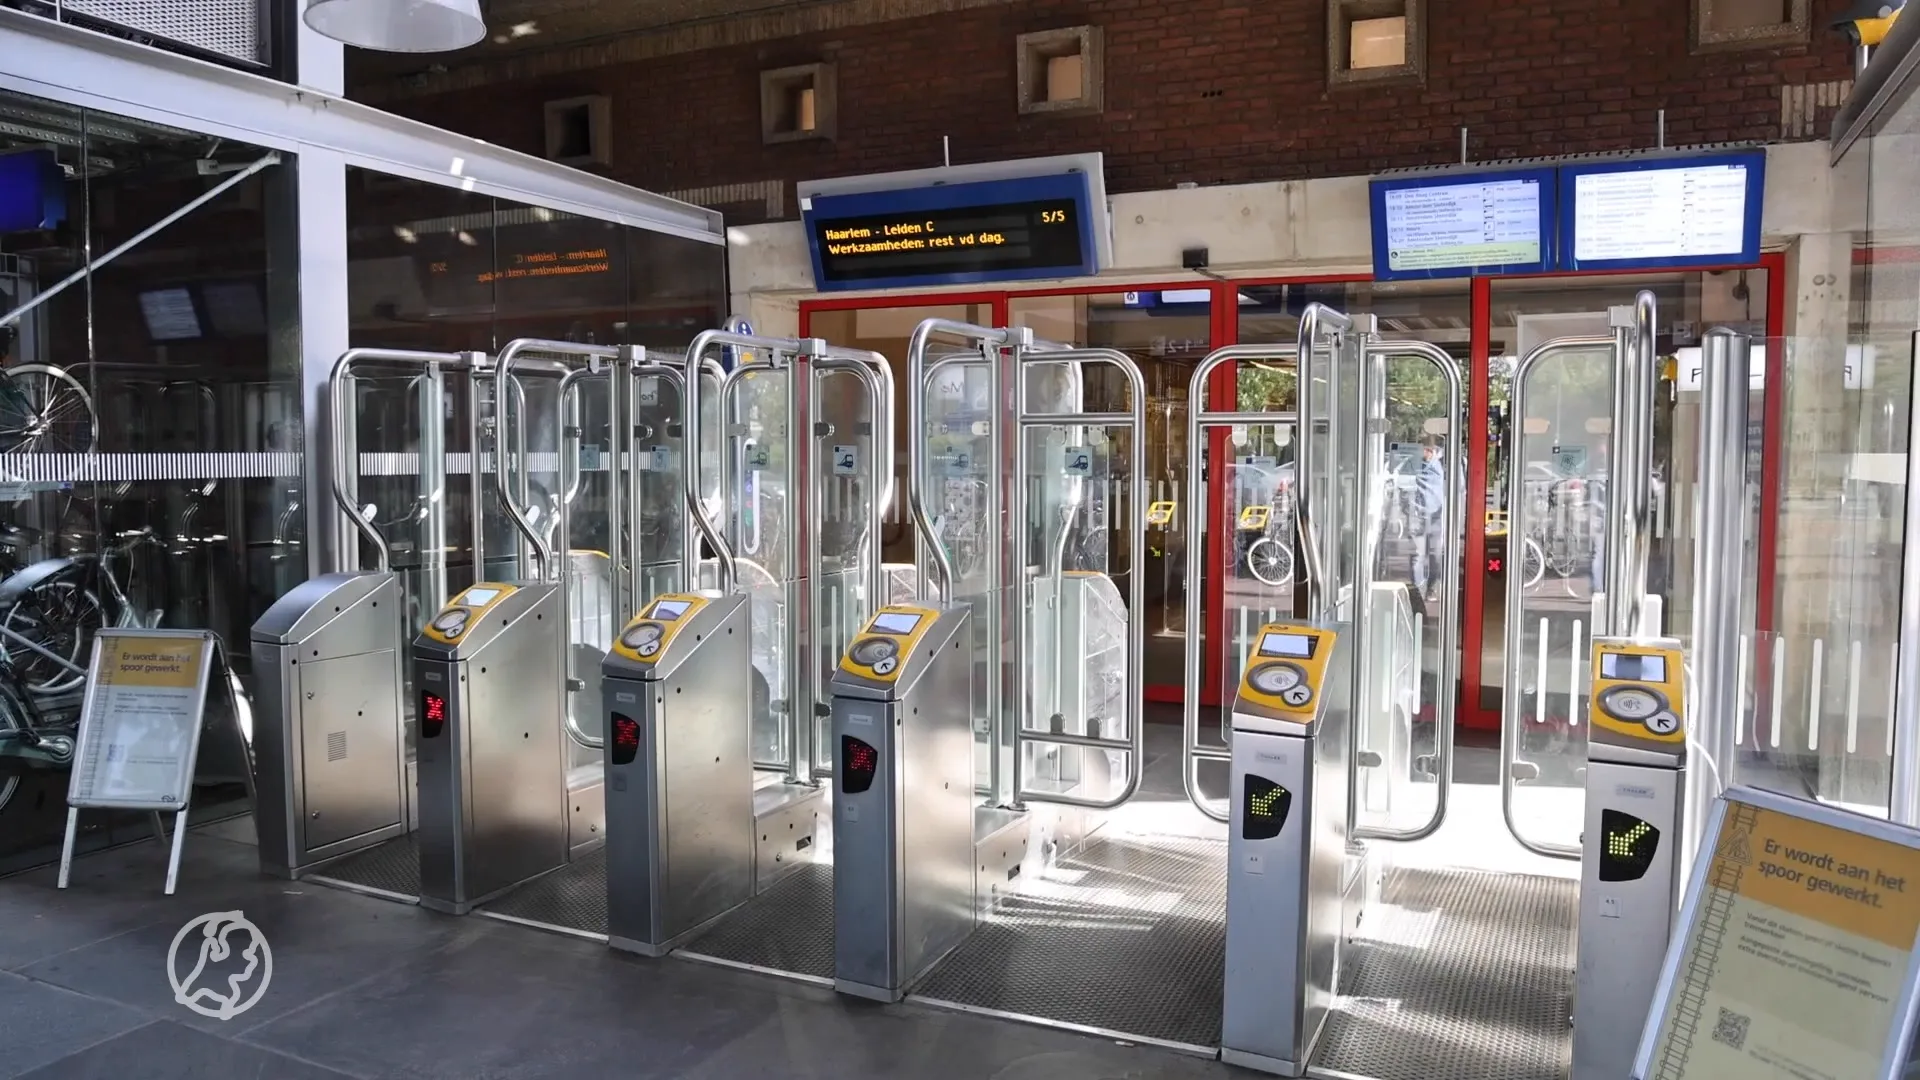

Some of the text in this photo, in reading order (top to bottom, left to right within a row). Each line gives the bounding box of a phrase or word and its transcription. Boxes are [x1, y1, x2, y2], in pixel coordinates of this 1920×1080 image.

[1042, 210, 1066, 223] 5/5
[825, 228, 871, 241] Haarlem
[884, 223, 922, 236] Leiden
[926, 221, 935, 232] C
[828, 232, 1005, 255] Werkzaamheden: rest vd dag.
[122, 652, 131, 661] Er
[132, 652, 158, 661] wordt
[159, 654, 175, 662] aan
[120, 663, 144, 673] spoor
[1763, 838, 1907, 892] Er wordt aan het
[1758, 860, 1883, 909] spoor gewerkt.
[1747, 912, 1768, 925] Vanaf
[1767, 919, 1778, 929] dit
[1738, 943, 1756, 956] extra
